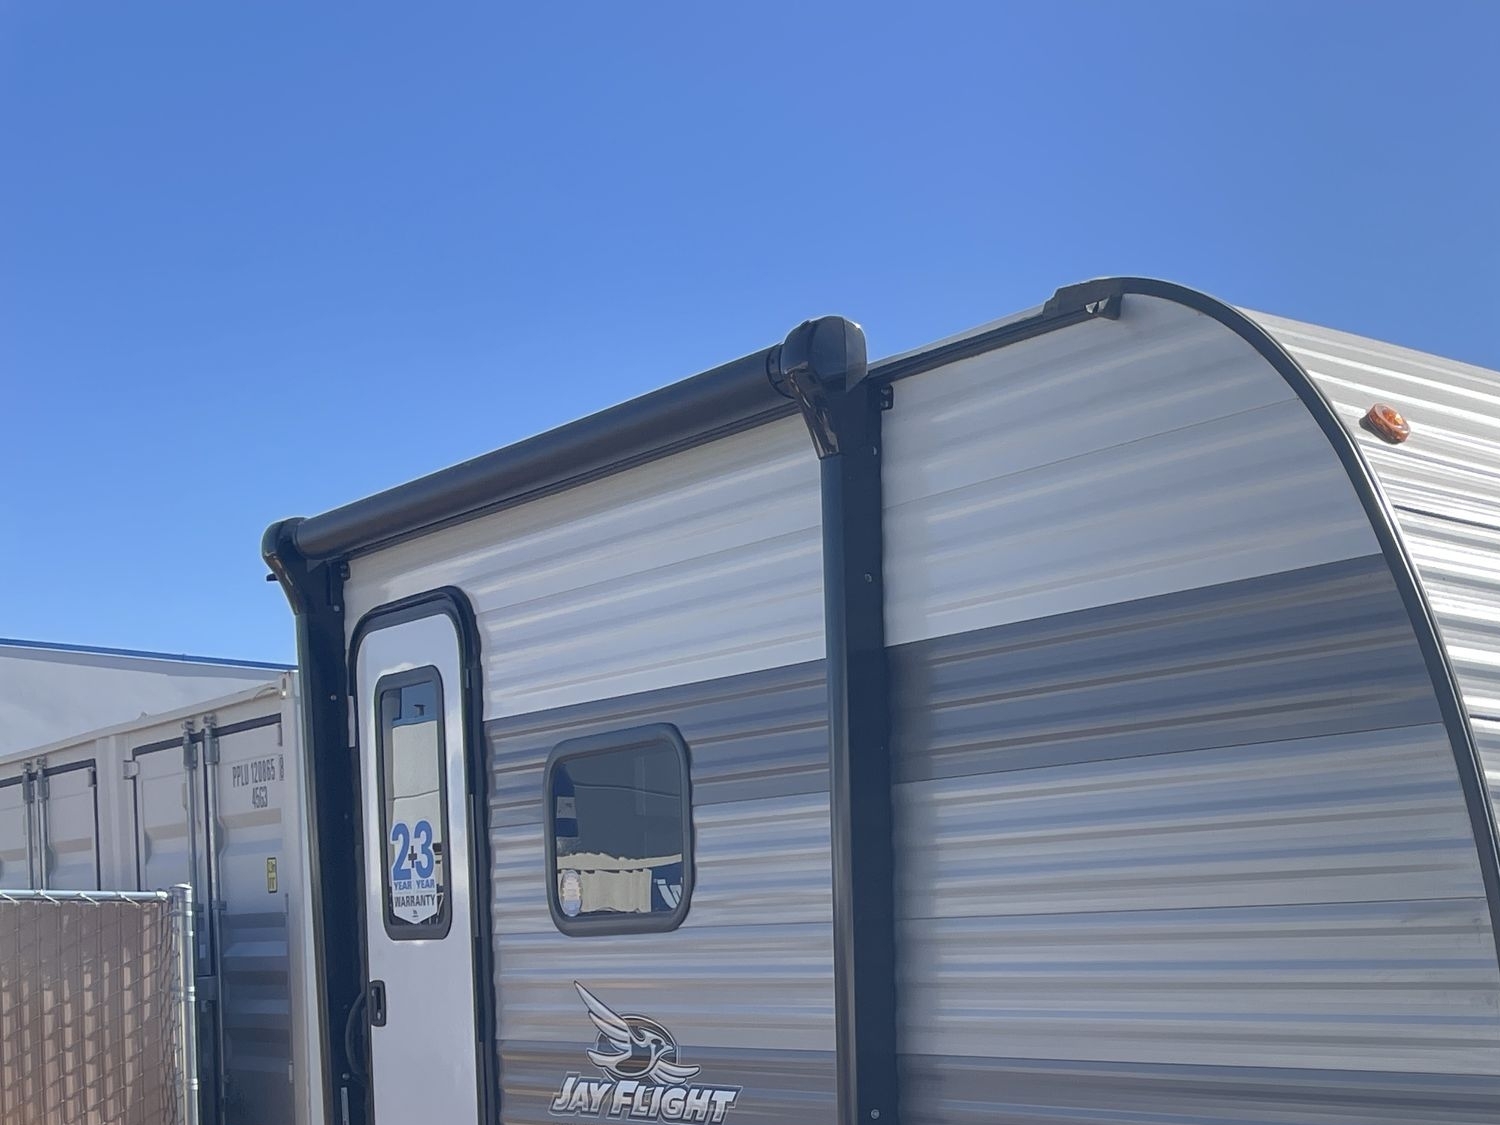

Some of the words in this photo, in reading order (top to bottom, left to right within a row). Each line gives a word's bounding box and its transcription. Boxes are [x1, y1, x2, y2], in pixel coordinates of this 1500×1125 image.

[393, 880, 412, 891] YEAR
[415, 879, 435, 890] YEAR
[394, 894, 436, 908] WARRANTY
[549, 1073, 613, 1116] JAY
